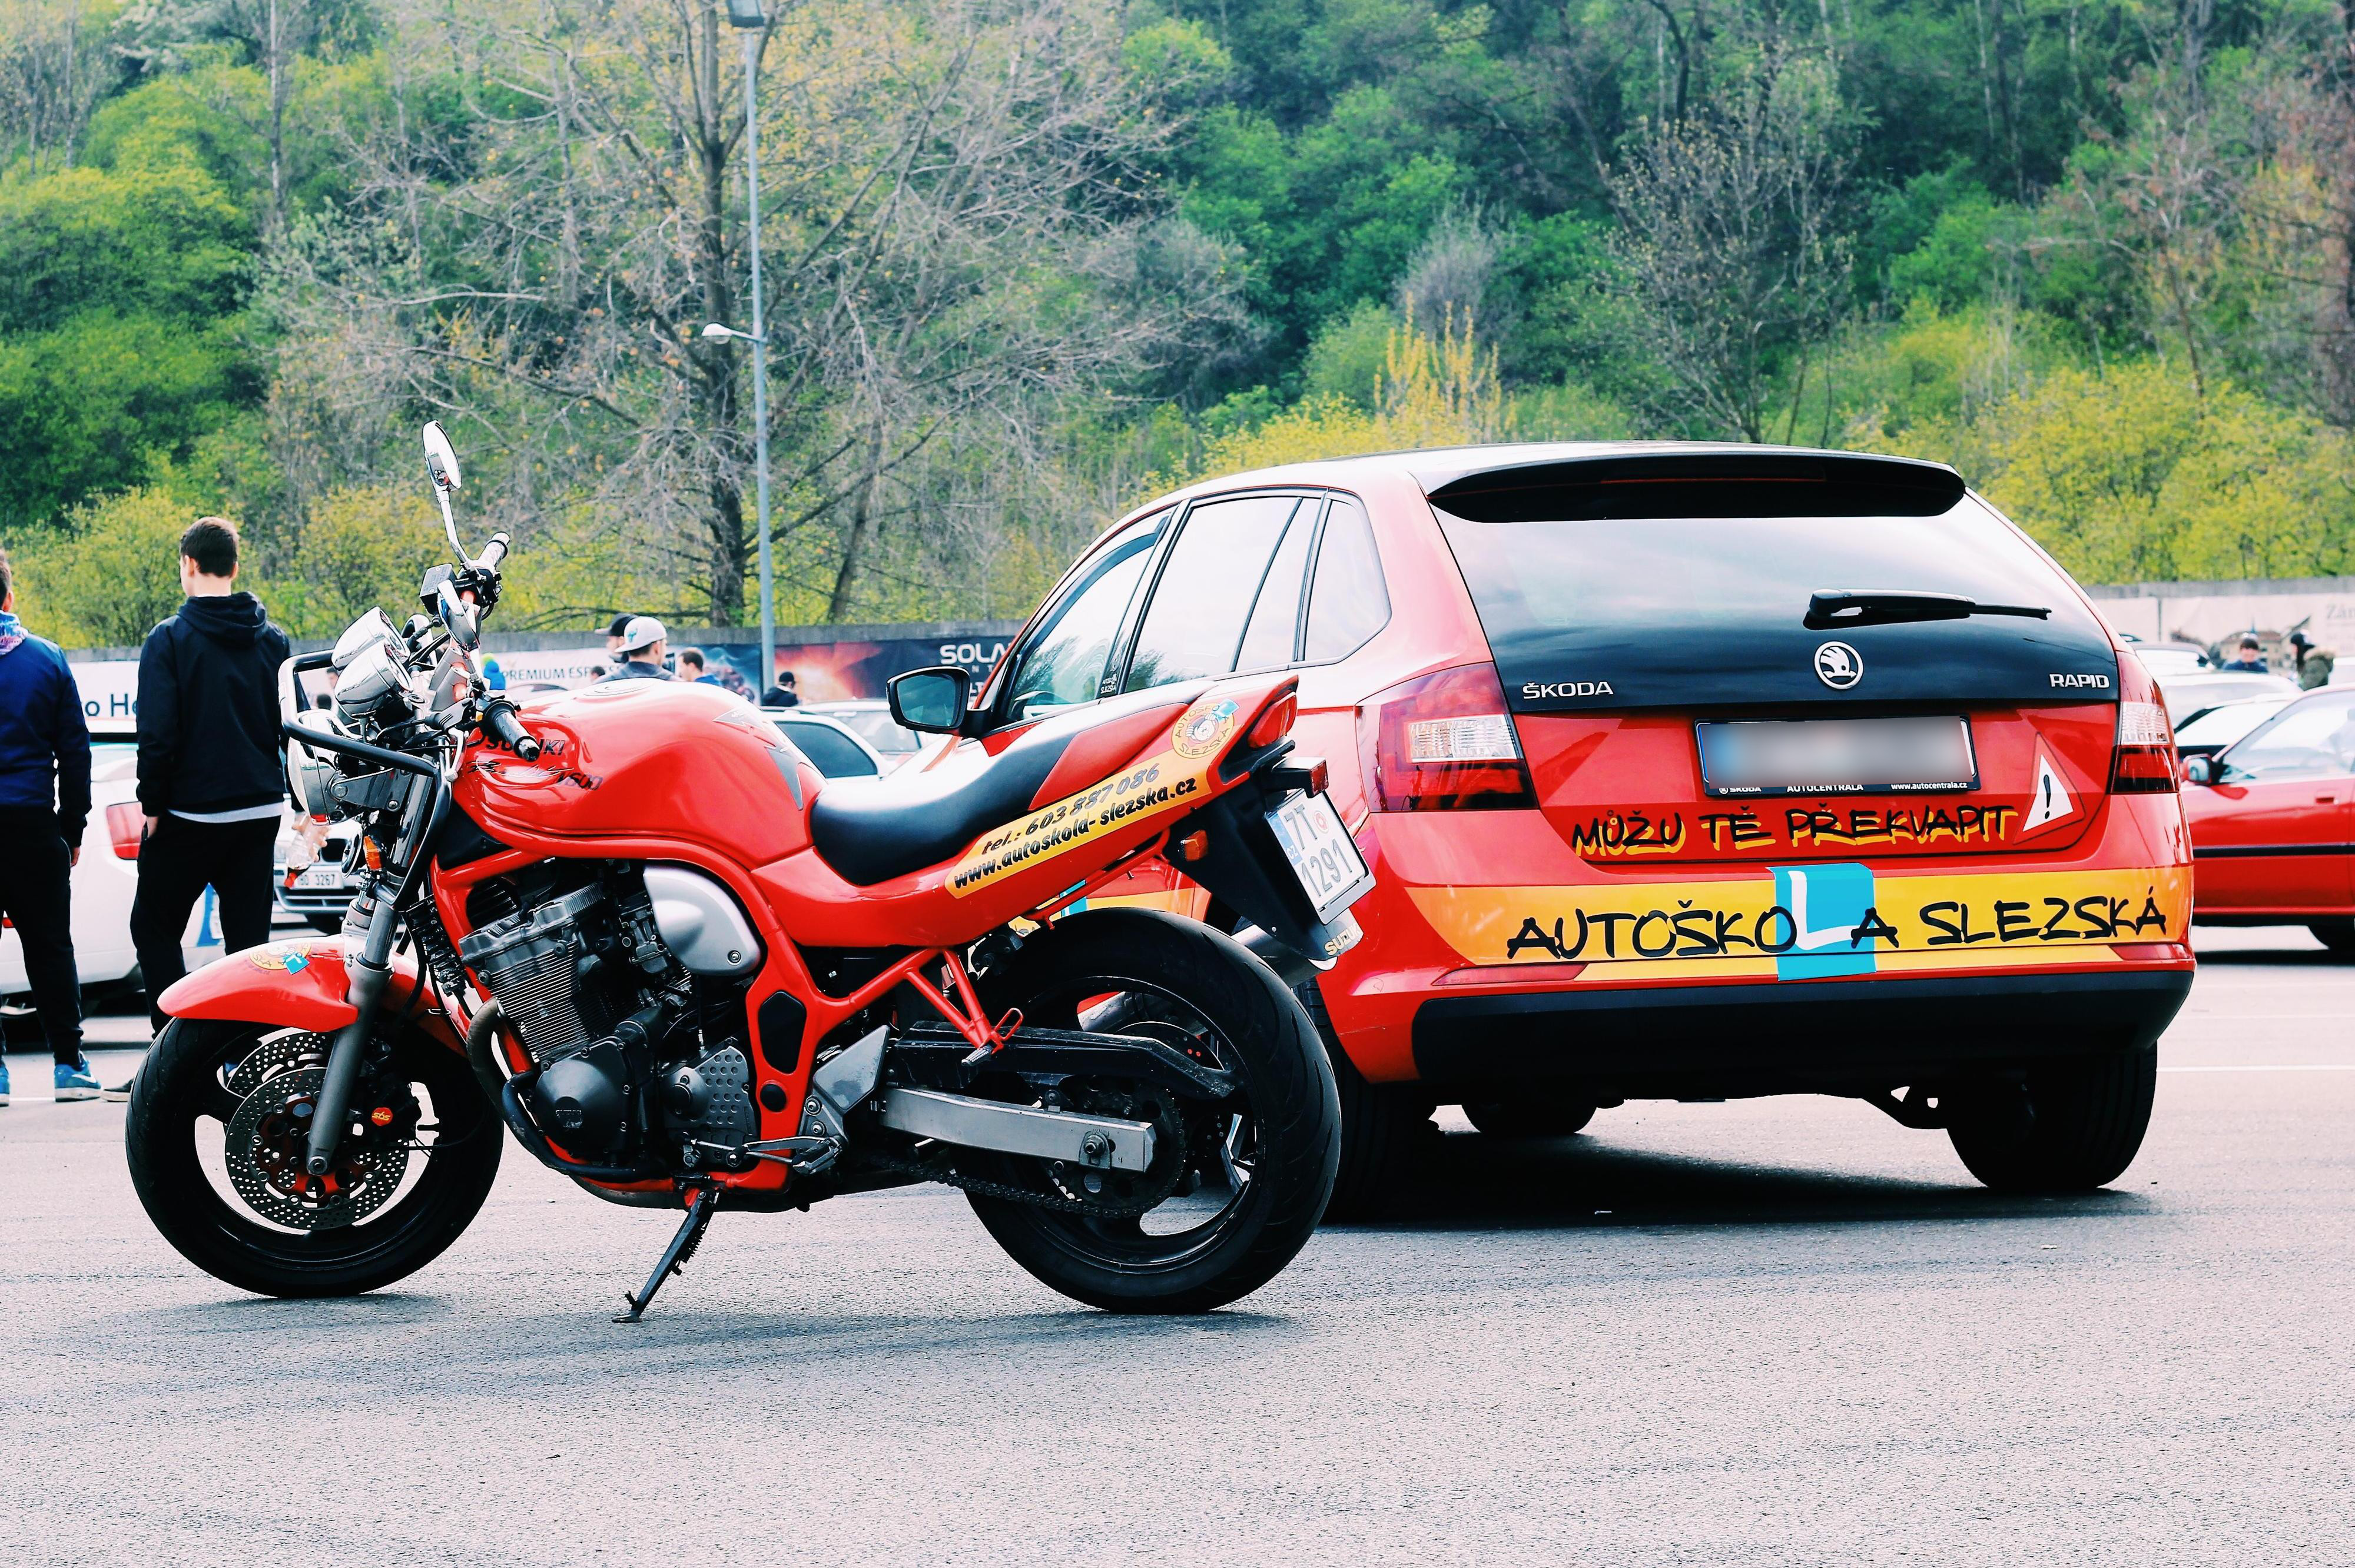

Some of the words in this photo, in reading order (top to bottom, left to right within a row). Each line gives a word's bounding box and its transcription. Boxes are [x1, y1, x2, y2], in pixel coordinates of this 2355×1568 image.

[940, 643, 1011, 665] SOLA
[1523, 682, 1614, 699] ŠKODA
[2049, 673, 2110, 689] RAPID
[1786, 784, 1864, 792] AUTOCENTRALA
[1891, 782, 1968, 790] www.autocentrala.cz
[981, 830, 1021, 855] tel.:
[1026, 810, 1066, 835] 603
[1069, 783, 1113, 816] 887
[1116, 763, 1160, 795] 086
[1285, 803, 1318, 850] 7T
[1572, 810, 1686, 855] MŮŽU
[1699, 806, 1776, 851] TĚ
[1785, 803, 2018, 847] PŘEKVAPIT
[1286, 847, 1298, 860] CZ
[1301, 838, 1352, 898] 1291
[1919, 886, 2167, 945] SLEZSKÁ
